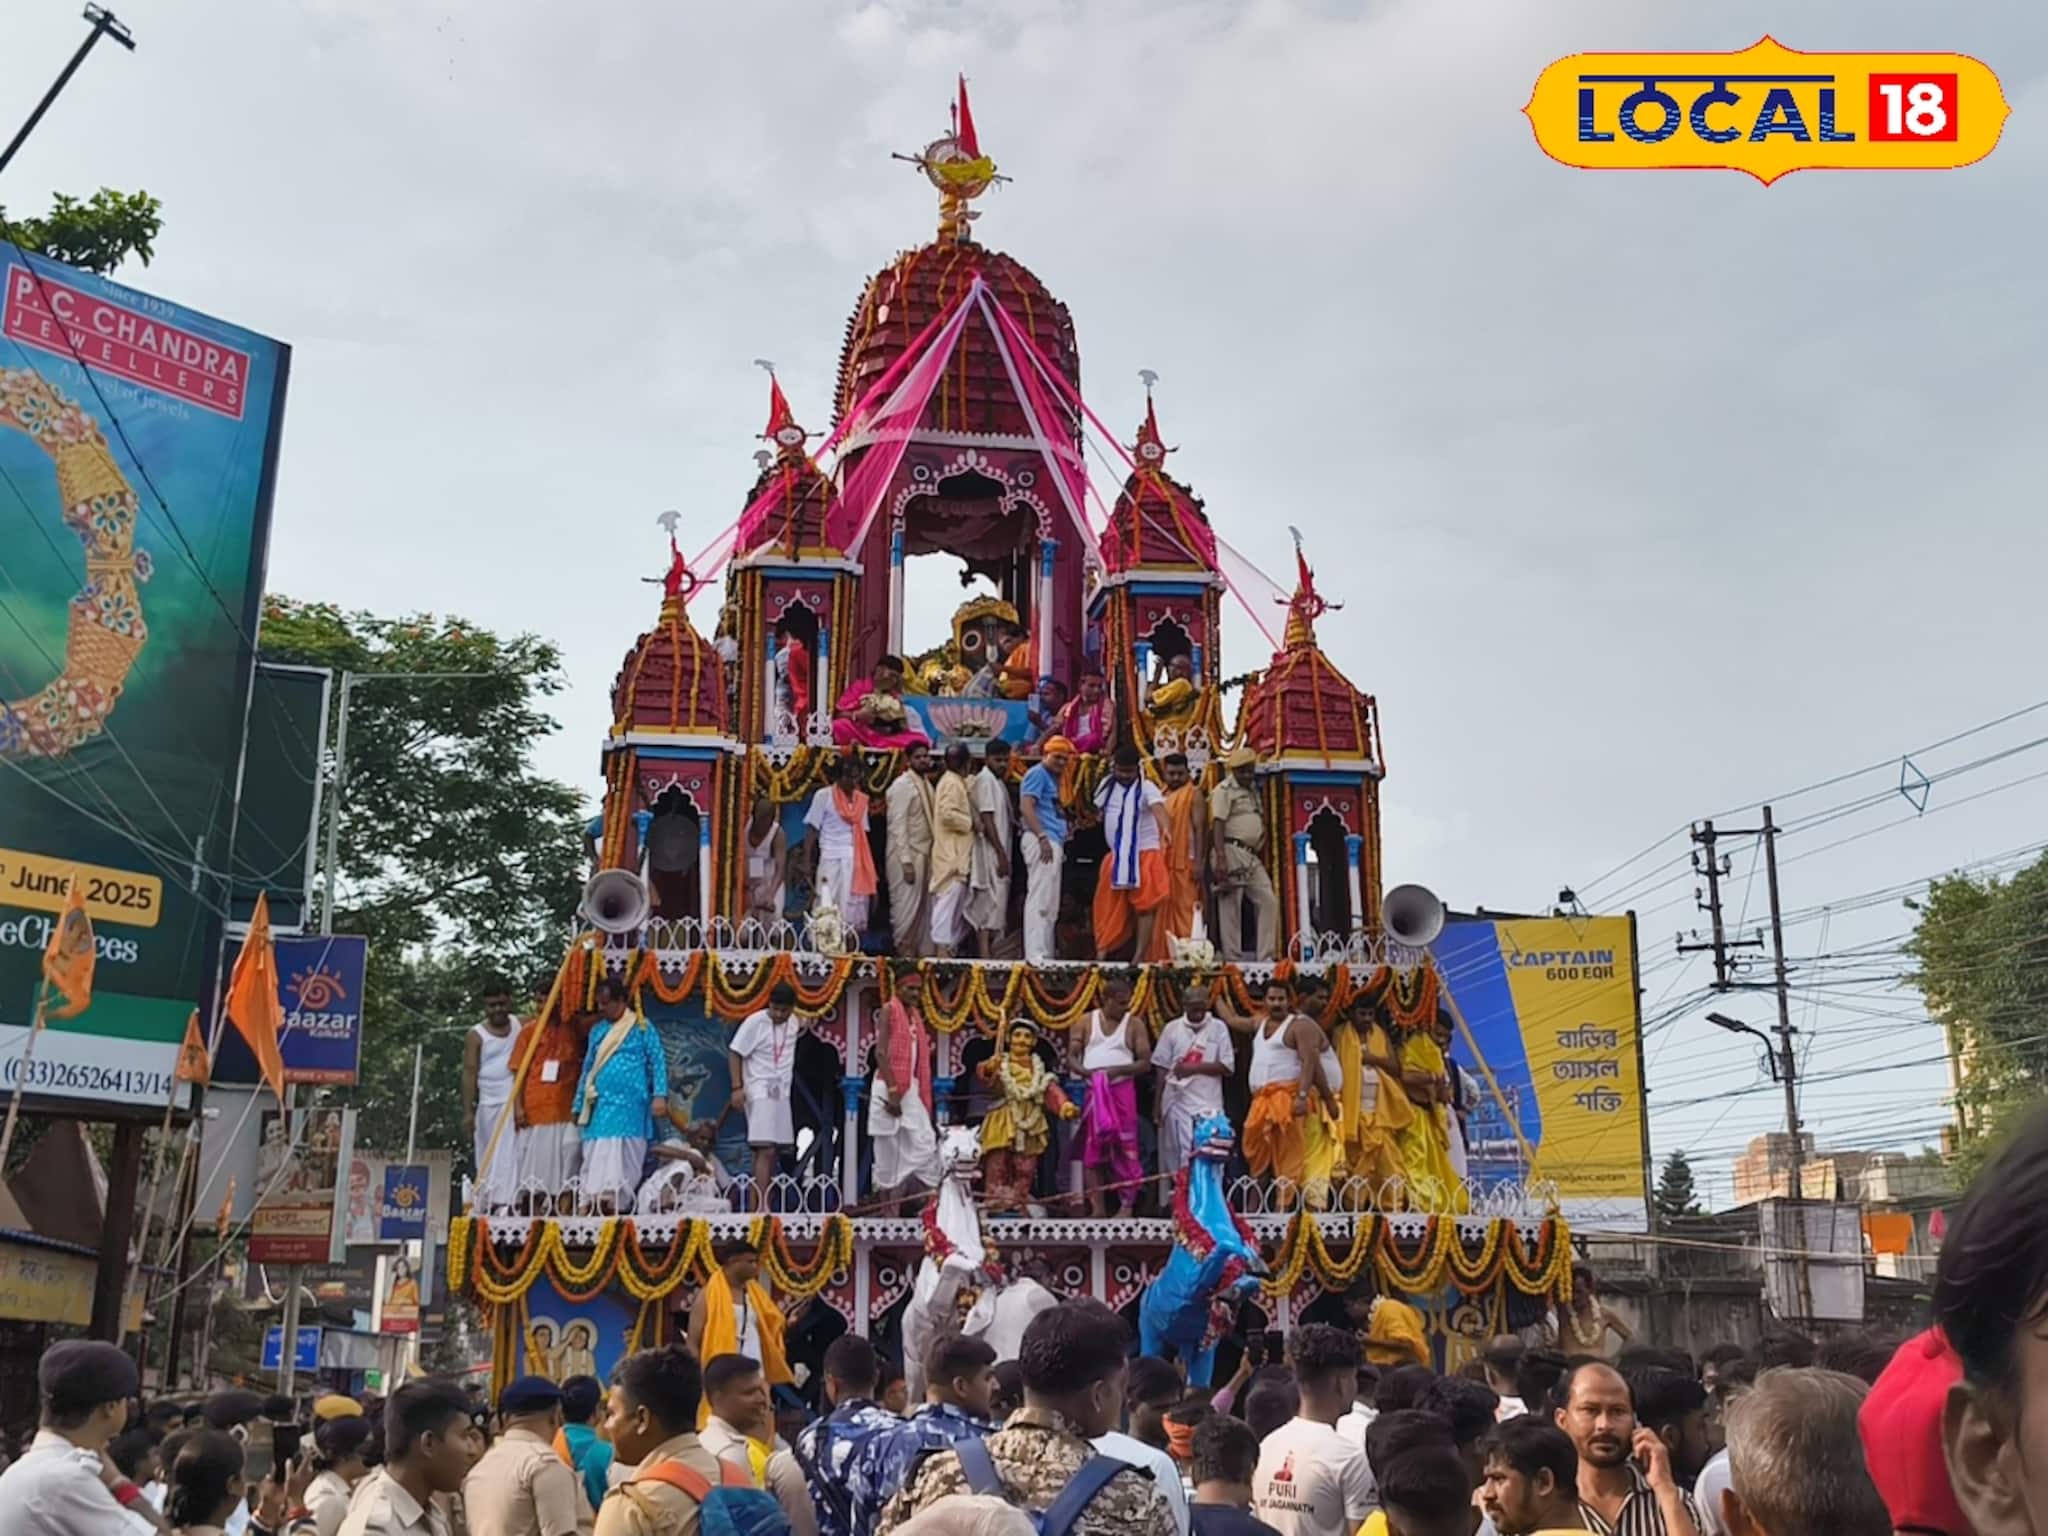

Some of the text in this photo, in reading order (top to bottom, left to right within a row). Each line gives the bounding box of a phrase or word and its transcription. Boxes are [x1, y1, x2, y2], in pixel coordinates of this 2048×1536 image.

[143, 296, 176, 320] 1939
[15, 275, 239, 382] P. C. CHANDRA
[12, 310, 238, 406] JEWELLERS
[86, 877, 153, 910] 2025
[1510, 949, 1614, 966] CAPTAIN
[1546, 967, 1579, 981] 600
[1555, 1023, 1619, 1052] বাড়ির
[1551, 1060, 1620, 1079] আসল
[1573, 1085, 1623, 1113] শক্তি
[1268, 1481, 1297, 1499] PURI
